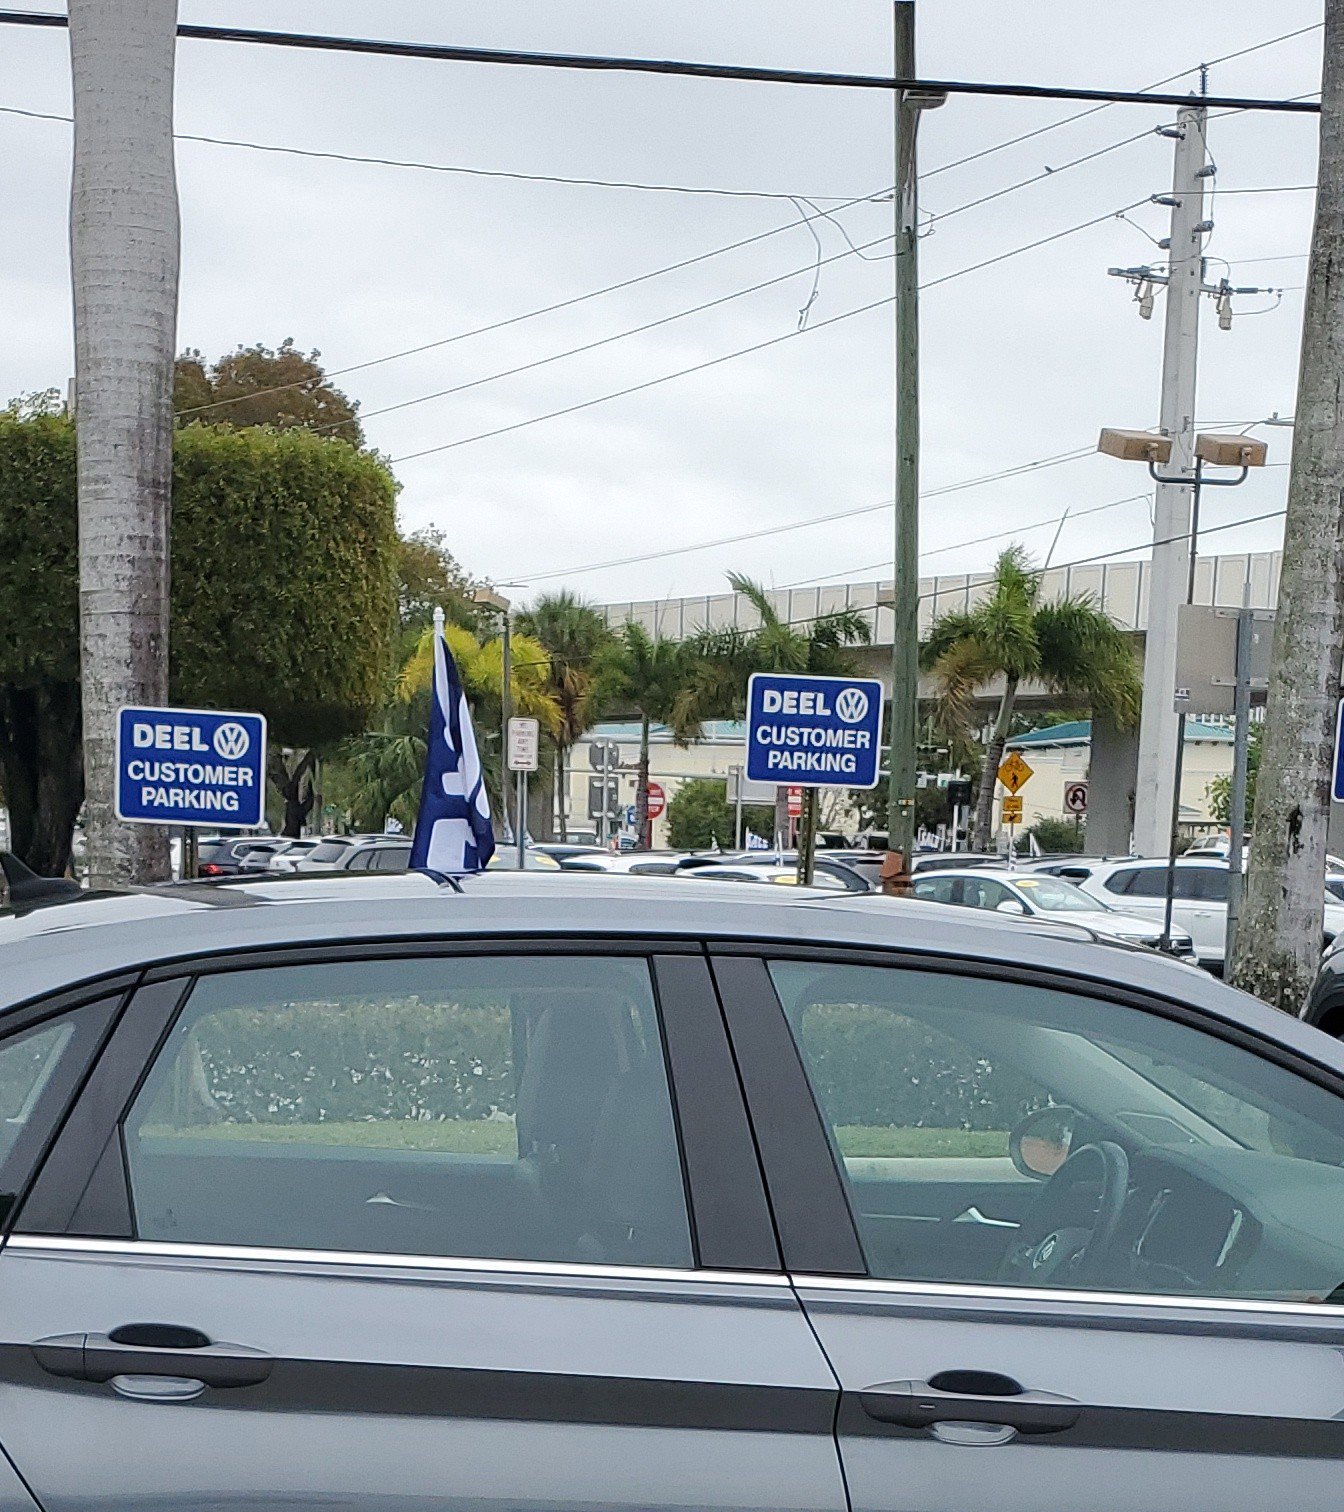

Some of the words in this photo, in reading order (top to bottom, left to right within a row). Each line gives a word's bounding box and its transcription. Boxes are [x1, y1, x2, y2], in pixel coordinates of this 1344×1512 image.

[762, 689, 832, 716] DEEL
[133, 723, 210, 752] DEEL
[756, 725, 871, 749] CUSTOMER
[127, 760, 253, 787] CUSTOMER
[767, 750, 856, 773] PARKING
[141, 786, 239, 811] PARKING
